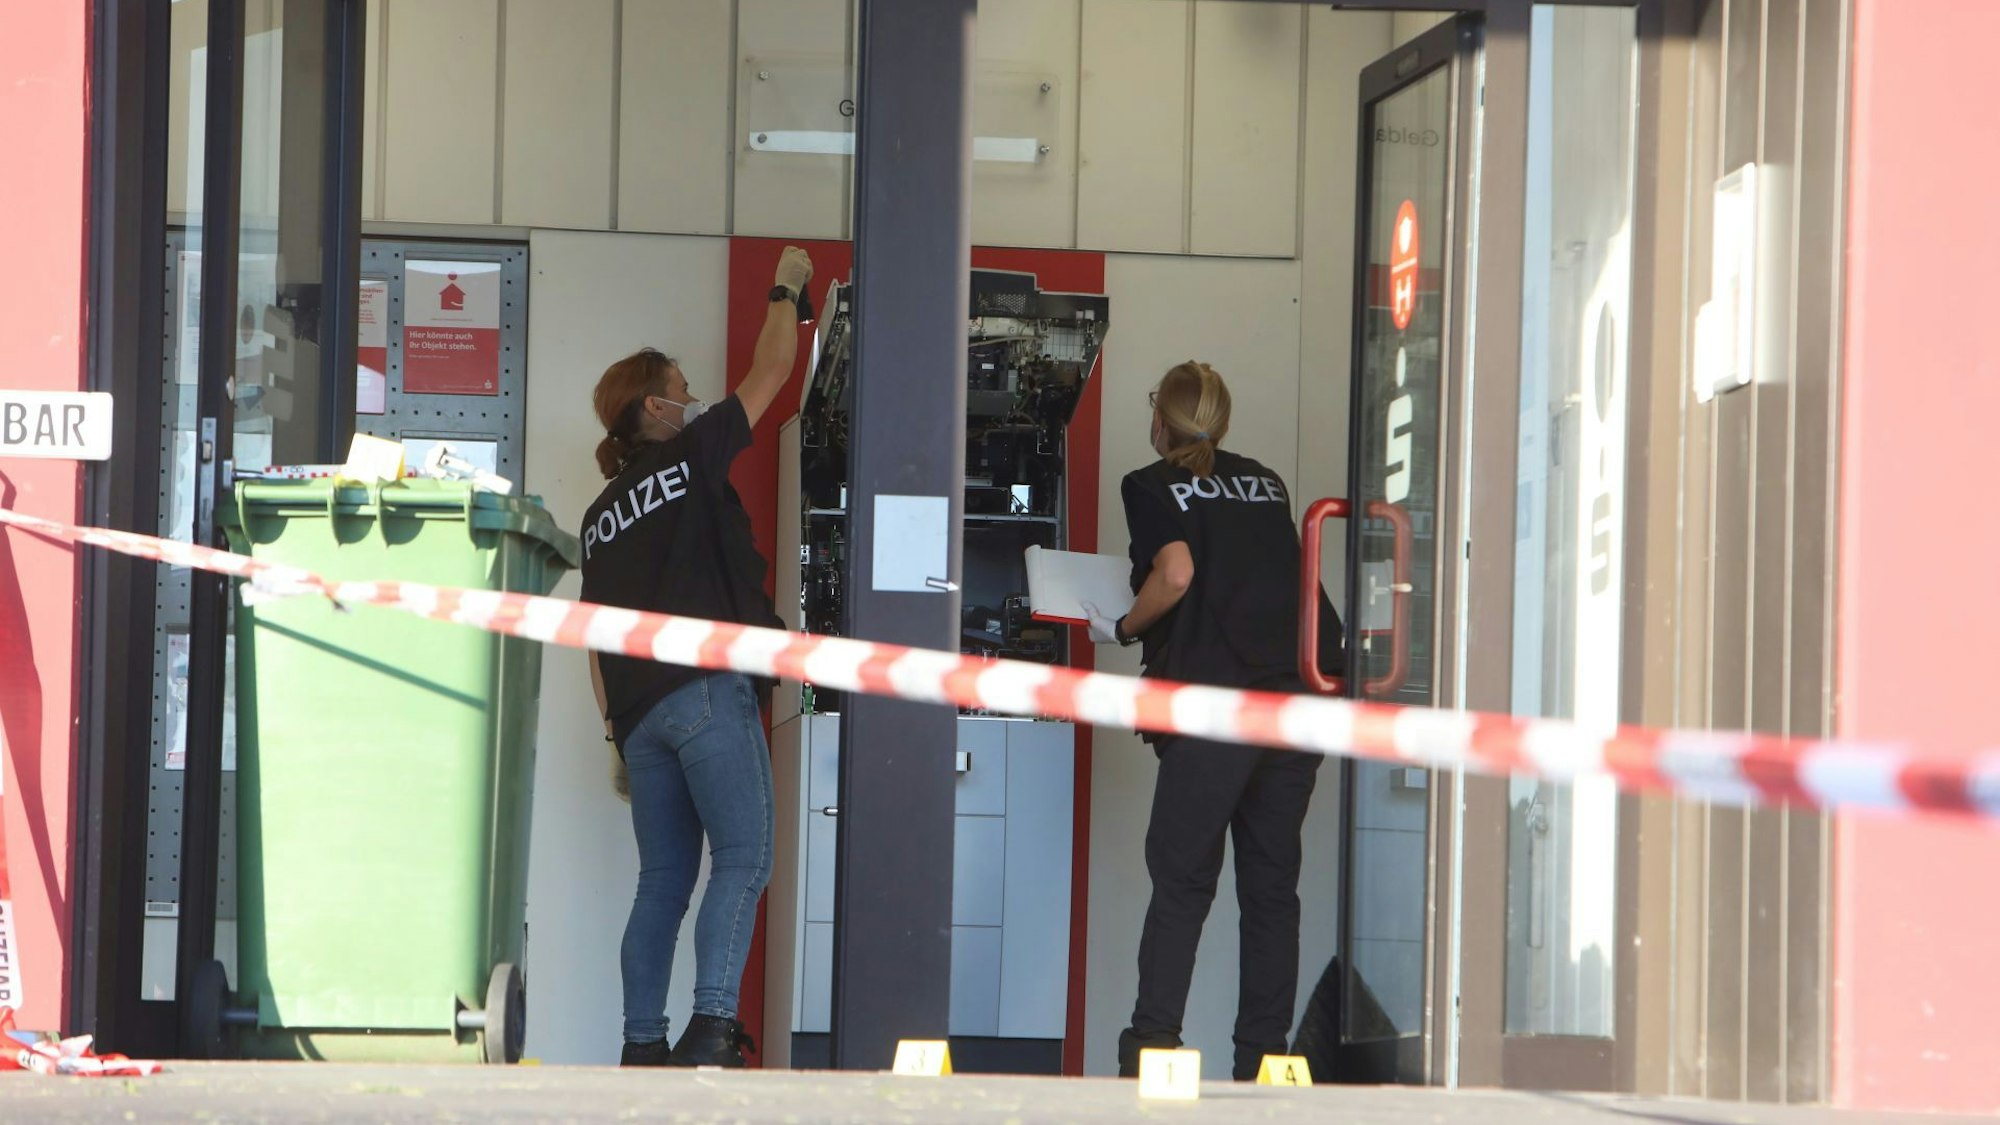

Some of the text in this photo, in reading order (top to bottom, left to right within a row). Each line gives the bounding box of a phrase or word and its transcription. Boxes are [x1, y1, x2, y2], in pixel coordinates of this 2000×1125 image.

[409, 331, 473, 340] Hier könnte auch
[409, 341, 477, 351] Ihr Objekt stehen.
[3, 402, 86, 446] BAR
